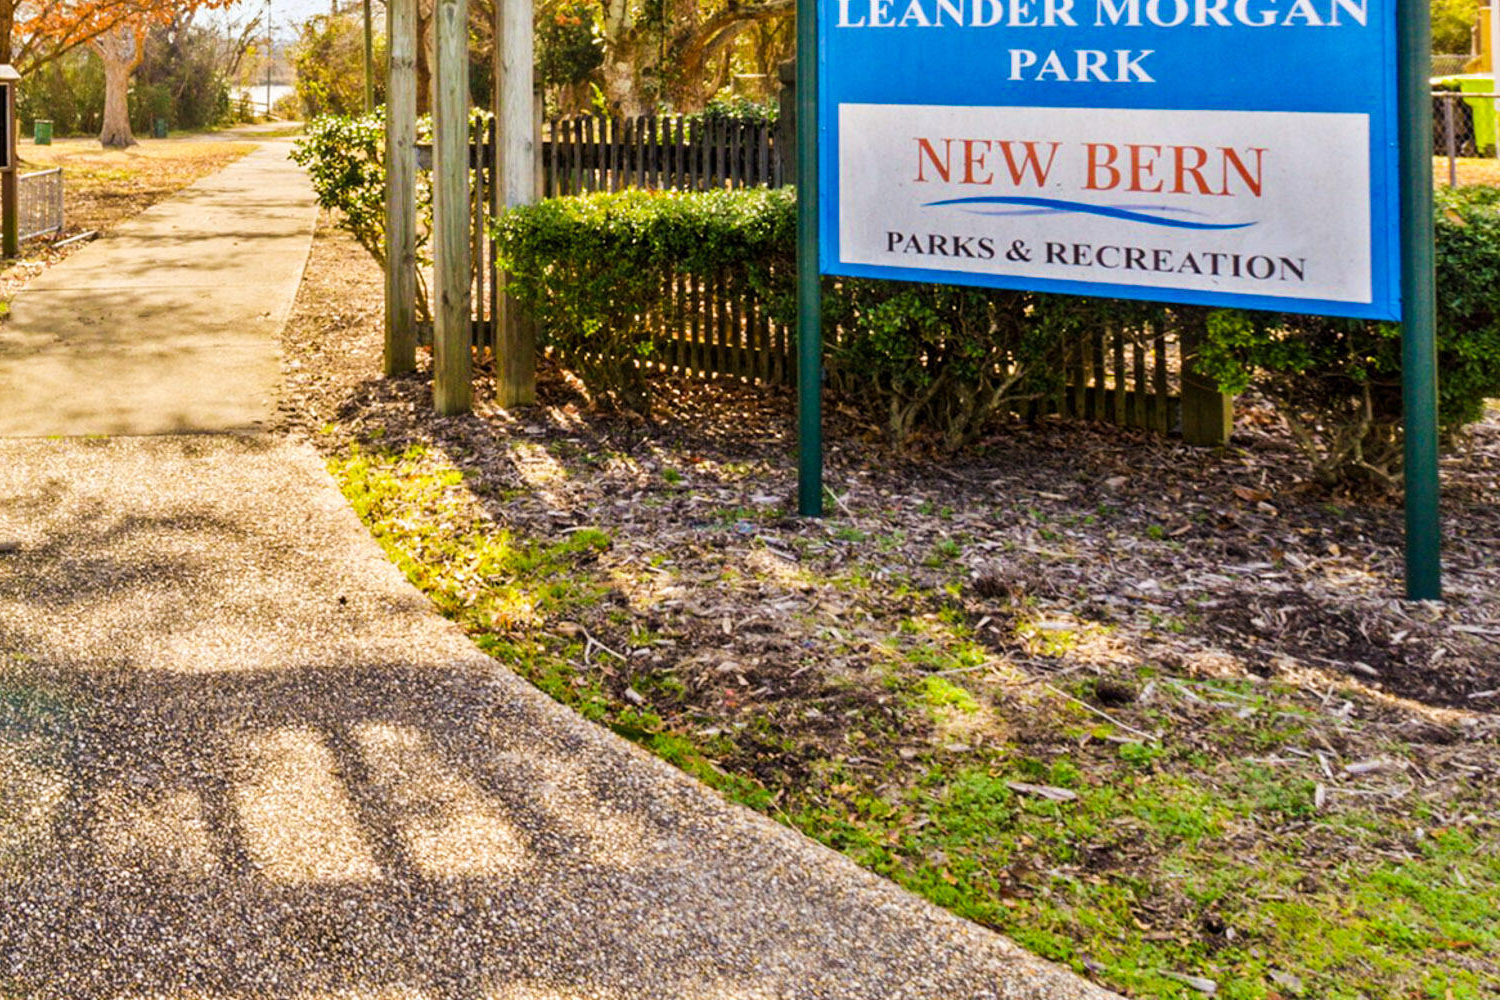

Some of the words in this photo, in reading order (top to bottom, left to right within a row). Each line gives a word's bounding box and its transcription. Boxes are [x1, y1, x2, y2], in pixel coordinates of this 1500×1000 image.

[1007, 49, 1157, 83] PARK
[912, 137, 1061, 188] NEW
[1081, 142, 1269, 198] BERN
[886, 231, 995, 261] PARKS
[1005, 239, 1032, 263] &
[1045, 241, 1306, 282] RECREATION
